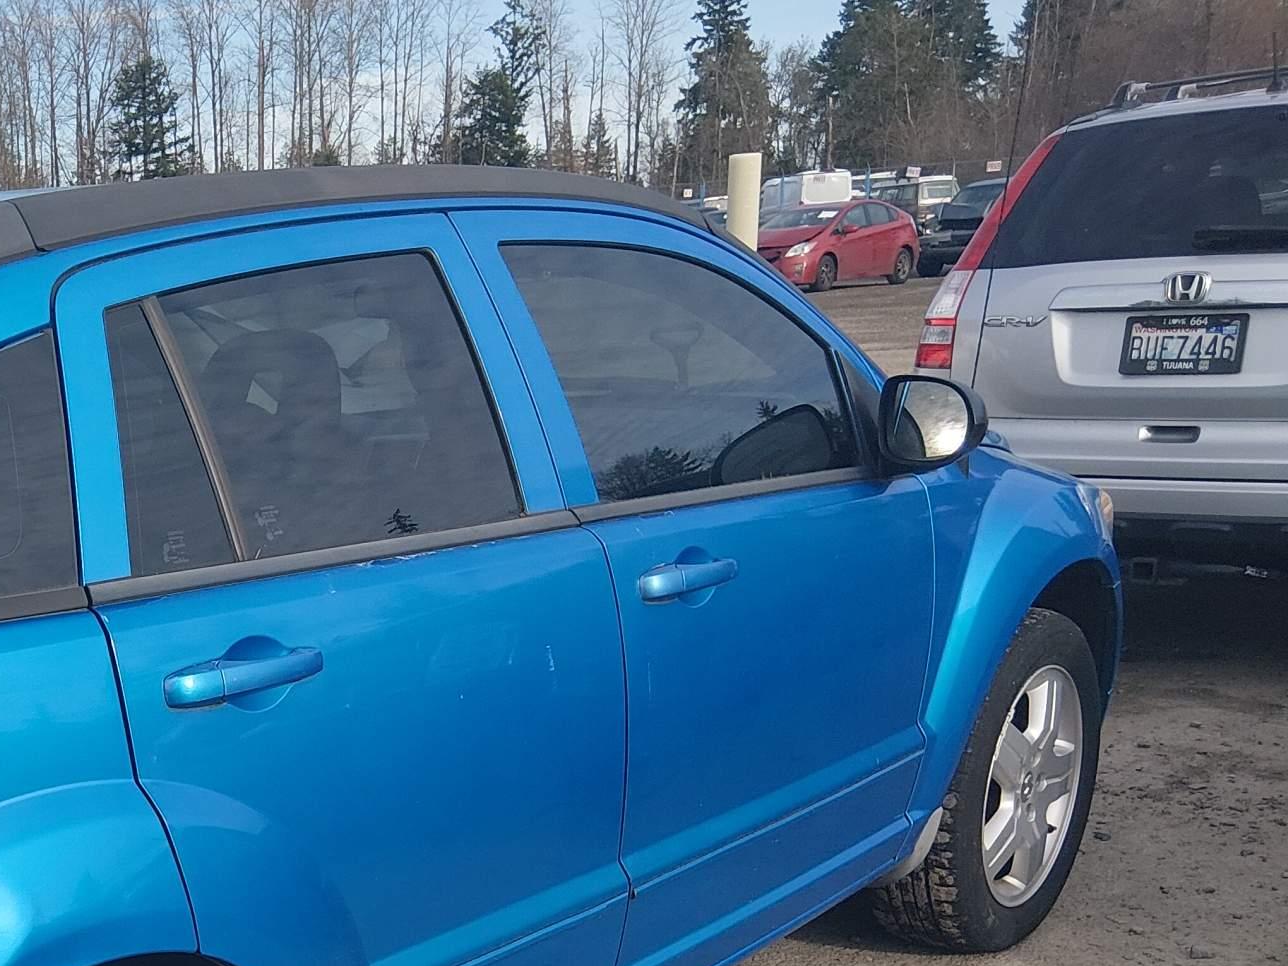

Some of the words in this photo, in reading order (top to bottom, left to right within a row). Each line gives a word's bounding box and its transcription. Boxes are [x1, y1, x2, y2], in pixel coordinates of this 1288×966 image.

[983, 314, 1049, 328] CR-V
[1189, 316, 1209, 326] 664
[1133, 325, 1199, 334] WASHINGTON
[1162, 361, 1194, 370] TIJUANA
